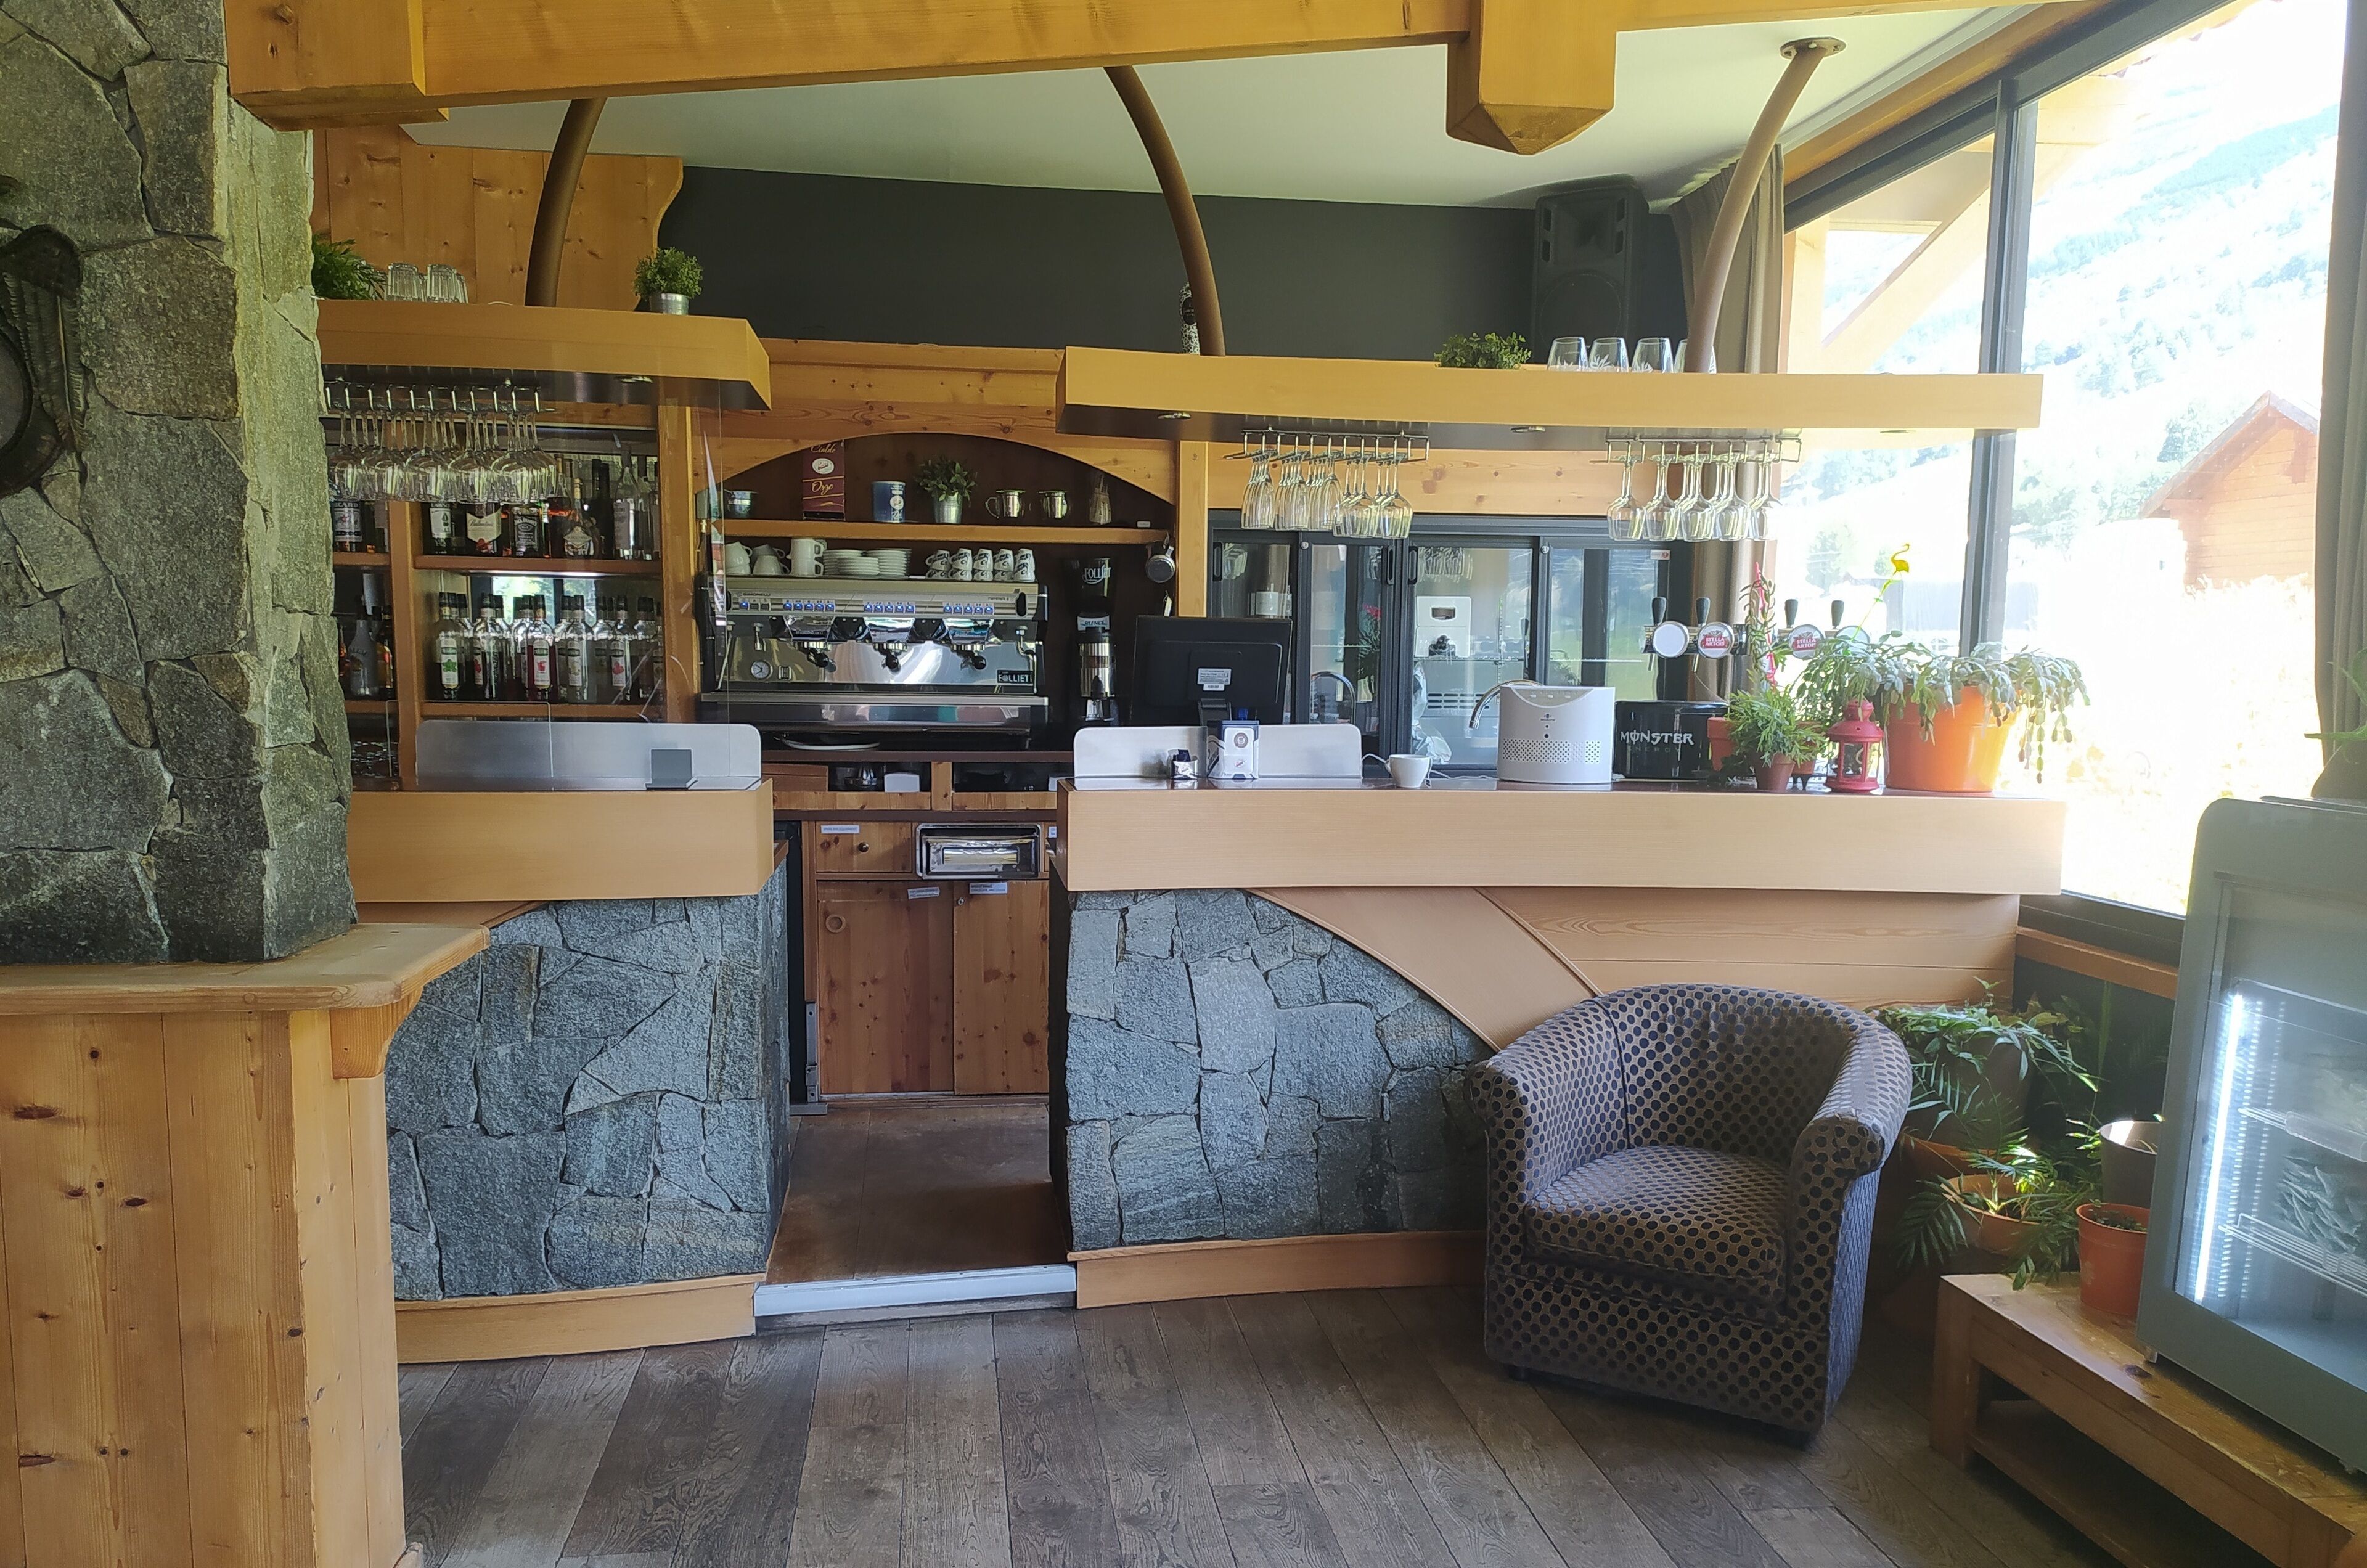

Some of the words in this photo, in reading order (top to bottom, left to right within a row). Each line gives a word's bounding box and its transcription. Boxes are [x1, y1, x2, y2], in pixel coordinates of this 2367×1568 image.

[810, 442, 836, 454] Cialde
[811, 480, 834, 496] Orzo
[1084, 565, 1111, 581] FOLLIET
[999, 674, 1029, 682] FOLLIET
[1620, 729, 1695, 746] MONSTER
